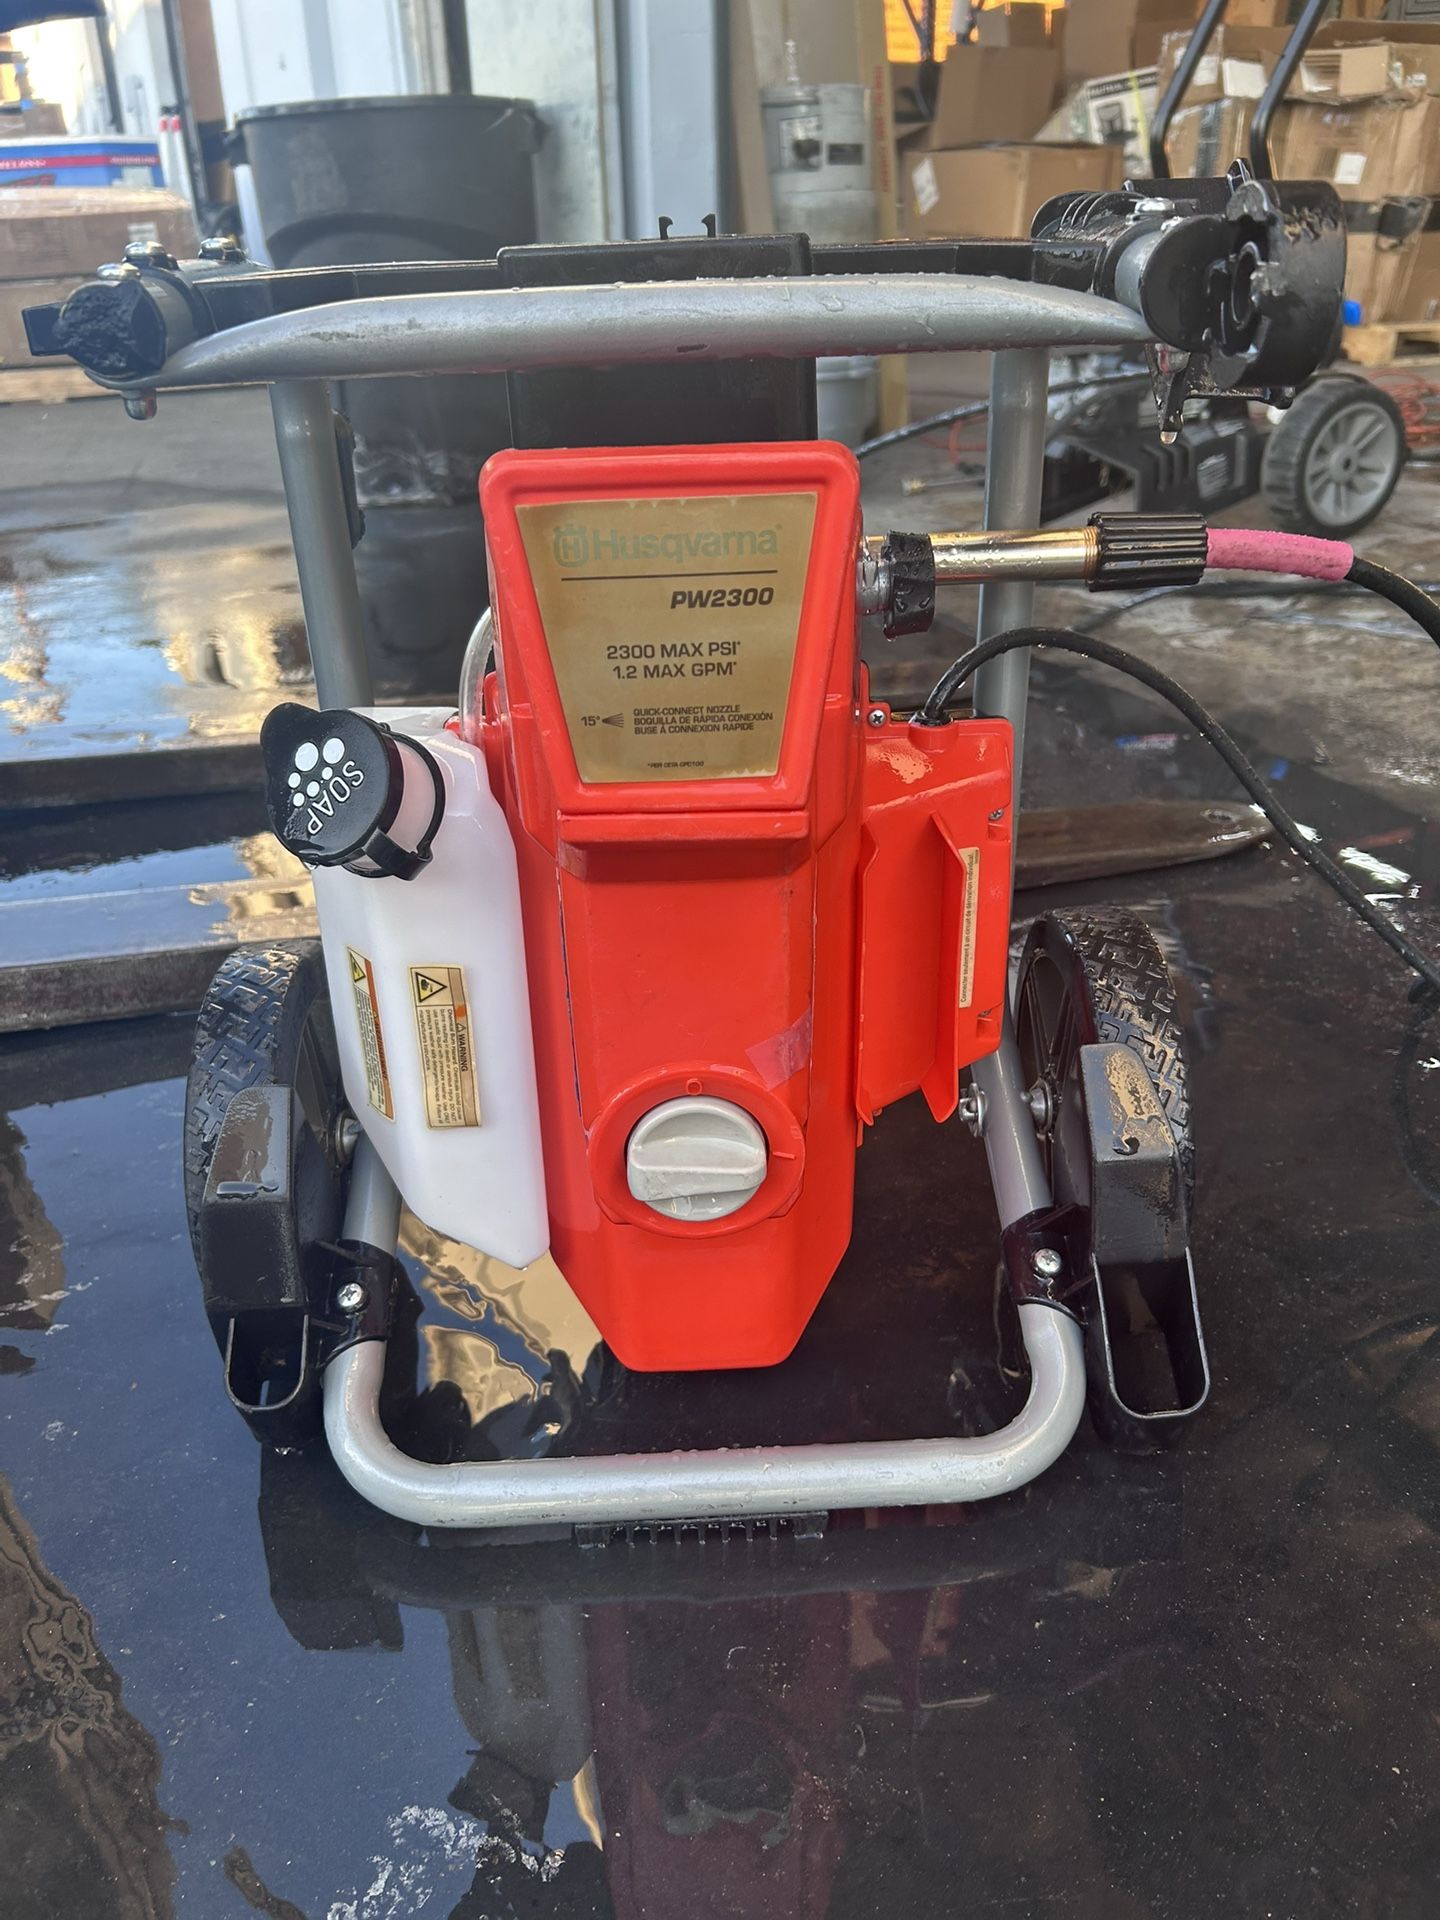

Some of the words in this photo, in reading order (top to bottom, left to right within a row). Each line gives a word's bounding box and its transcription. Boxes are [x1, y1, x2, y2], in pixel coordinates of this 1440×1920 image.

[593, 528, 778, 563] Husqvarna
[671, 587, 774, 609] PW2300
[607, 645, 655, 660] 2300
[660, 643, 703, 658] MAX
[612, 665, 637, 679] 1.2
[643, 664, 685, 678] MAX
[633, 706, 704, 717] QUICK-CONNECT
[706, 705, 741, 714] NOZZLE
[634, 716, 677, 726] BOQUILLA
[679, 716, 691, 724] DE
[634, 726, 658, 735] BUSE
[668, 724, 720, 734] CONNEXION
[307, 760, 364, 835] SOAP
[459, 1034, 468, 1071] WARNING
